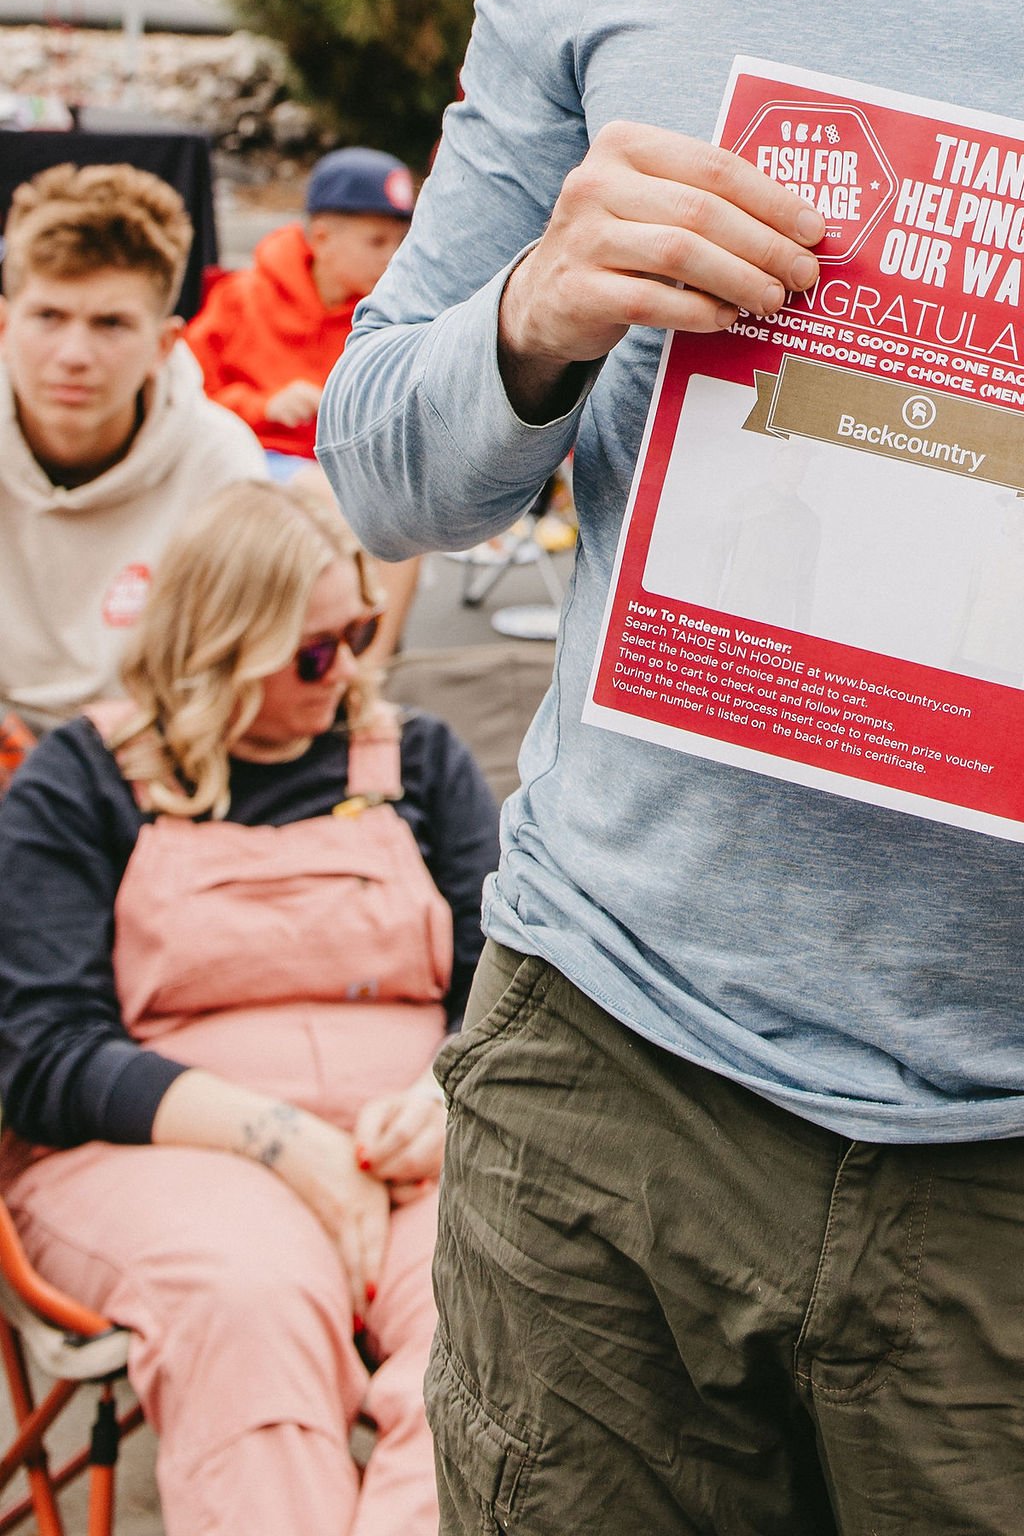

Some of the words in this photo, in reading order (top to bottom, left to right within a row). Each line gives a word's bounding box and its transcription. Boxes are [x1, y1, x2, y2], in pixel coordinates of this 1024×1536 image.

[757, 145, 810, 181] FISH
[813, 149, 858, 185] FOR
[878, 227, 953, 288] OUR
[770, 331, 808, 351] SUN
[808, 340, 878, 368] HOODIE
[878, 357, 906, 374] OF
[906, 364, 977, 394] CHOICE.
[836, 327, 855, 343] IS
[856, 333, 910, 356] GOOD
[910, 345, 950, 368] FOR
[950, 356, 991, 378] ONE
[836, 413, 987, 473] Backcountry
[627, 599, 658, 618] How
[660, 608, 676, 623] To
[677, 613, 731, 639] Redeem
[734, 628, 792, 655] Voucher:
[618, 645, 646, 664] Then
[647, 656, 664, 668] go
[665, 660, 679, 672] to
[680, 666, 704, 680] cart
[705, 671, 719, 684] to
[720, 676, 755, 694] check
[756, 687, 778, 700] out
[779, 693, 803, 707] and
[804, 697, 841, 717] follow
[842, 710, 896, 732] prompts.
[620, 631, 657, 650] Select
[658, 641, 678, 656] the
[679, 646, 719, 668] hoodie
[720, 660, 735, 671] of
[735, 664, 774, 683] choice
[775, 675, 800, 689] and
[800, 682, 825, 696] add
[826, 687, 840, 700] to
[841, 693, 868, 708] cart.
[624, 615, 667, 637] Search
[671, 627, 716, 651] TAHOE
[717, 641, 747, 659] SUN
[749, 649, 805, 674] HOODIE
[806, 667, 821, 679] at
[823, 671, 971, 718] www.backcountry.com
[611, 676, 658, 699] Voucher
[659, 692, 704, 712] number
[705, 703, 715, 716] is
[716, 706, 749, 725] listed
[750, 718, 766, 730] on
[772, 722, 792, 737] the
[793, 727, 823, 746] back
[824, 738, 840, 750] of
[840, 741, 862, 756] this
[864, 749, 927, 774] certificate.
[614, 661, 653, 683] During
[654, 673, 674, 688] the
[675, 680, 709, 698] check
[710, 691, 732, 704] out
[732, 697, 778, 717] process
[780, 707, 814, 727] insert
[815, 719, 846, 735] code
[848, 726, 861, 739] to
[863, 732, 909, 752] redeem
[910, 745, 942, 761] prize
[945, 753, 995, 774] voucher
